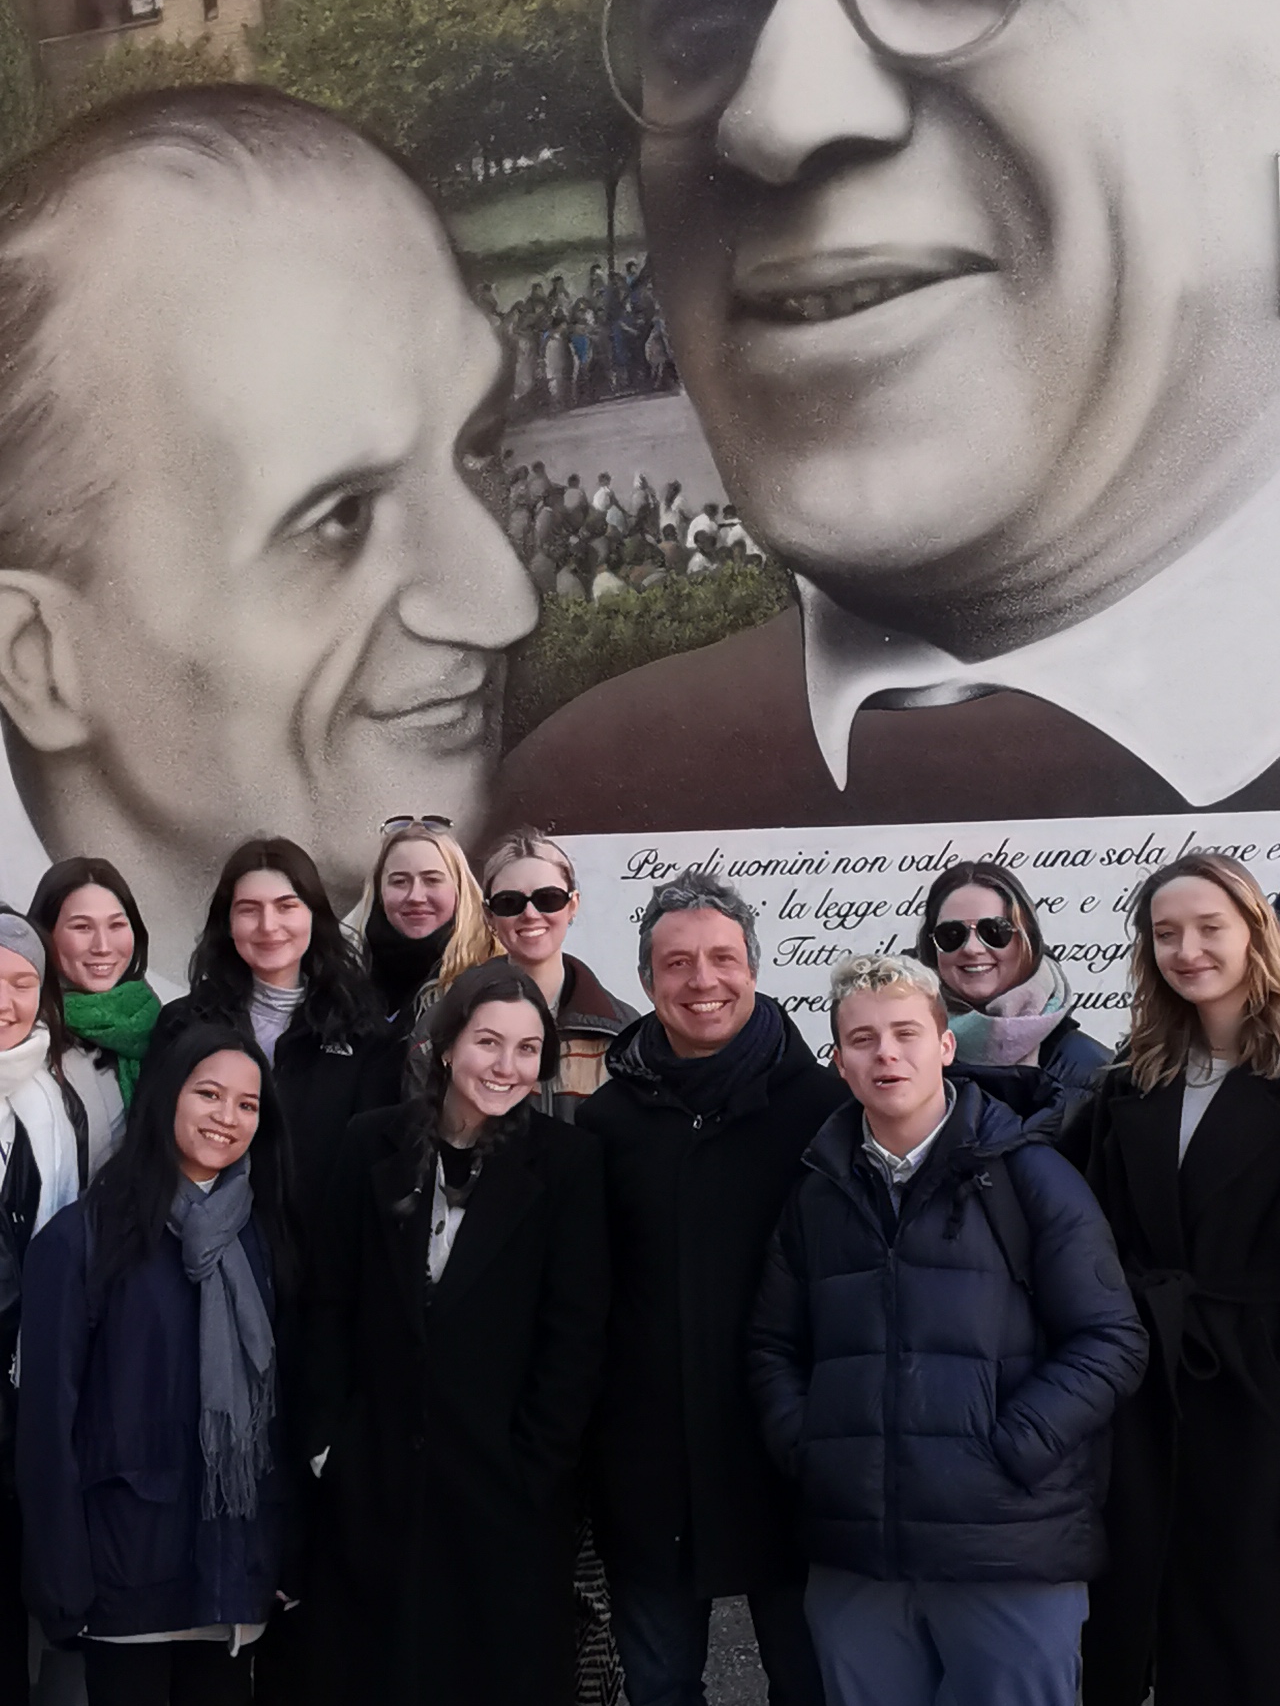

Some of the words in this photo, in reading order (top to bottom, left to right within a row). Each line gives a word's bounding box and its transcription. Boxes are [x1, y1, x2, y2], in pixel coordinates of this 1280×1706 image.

[620, 847, 680, 880] Per
[728, 850, 830, 877] uomini
[830, 854, 894, 874] non
[897, 839, 962, 872] vale
[974, 837, 1030, 869] che
[1033, 846, 1097, 868] una
[1099, 832, 1166, 867] sola
[778, 888, 810, 920] la
[813, 887, 894, 931] legge
[1080, 895, 1101, 913] e
